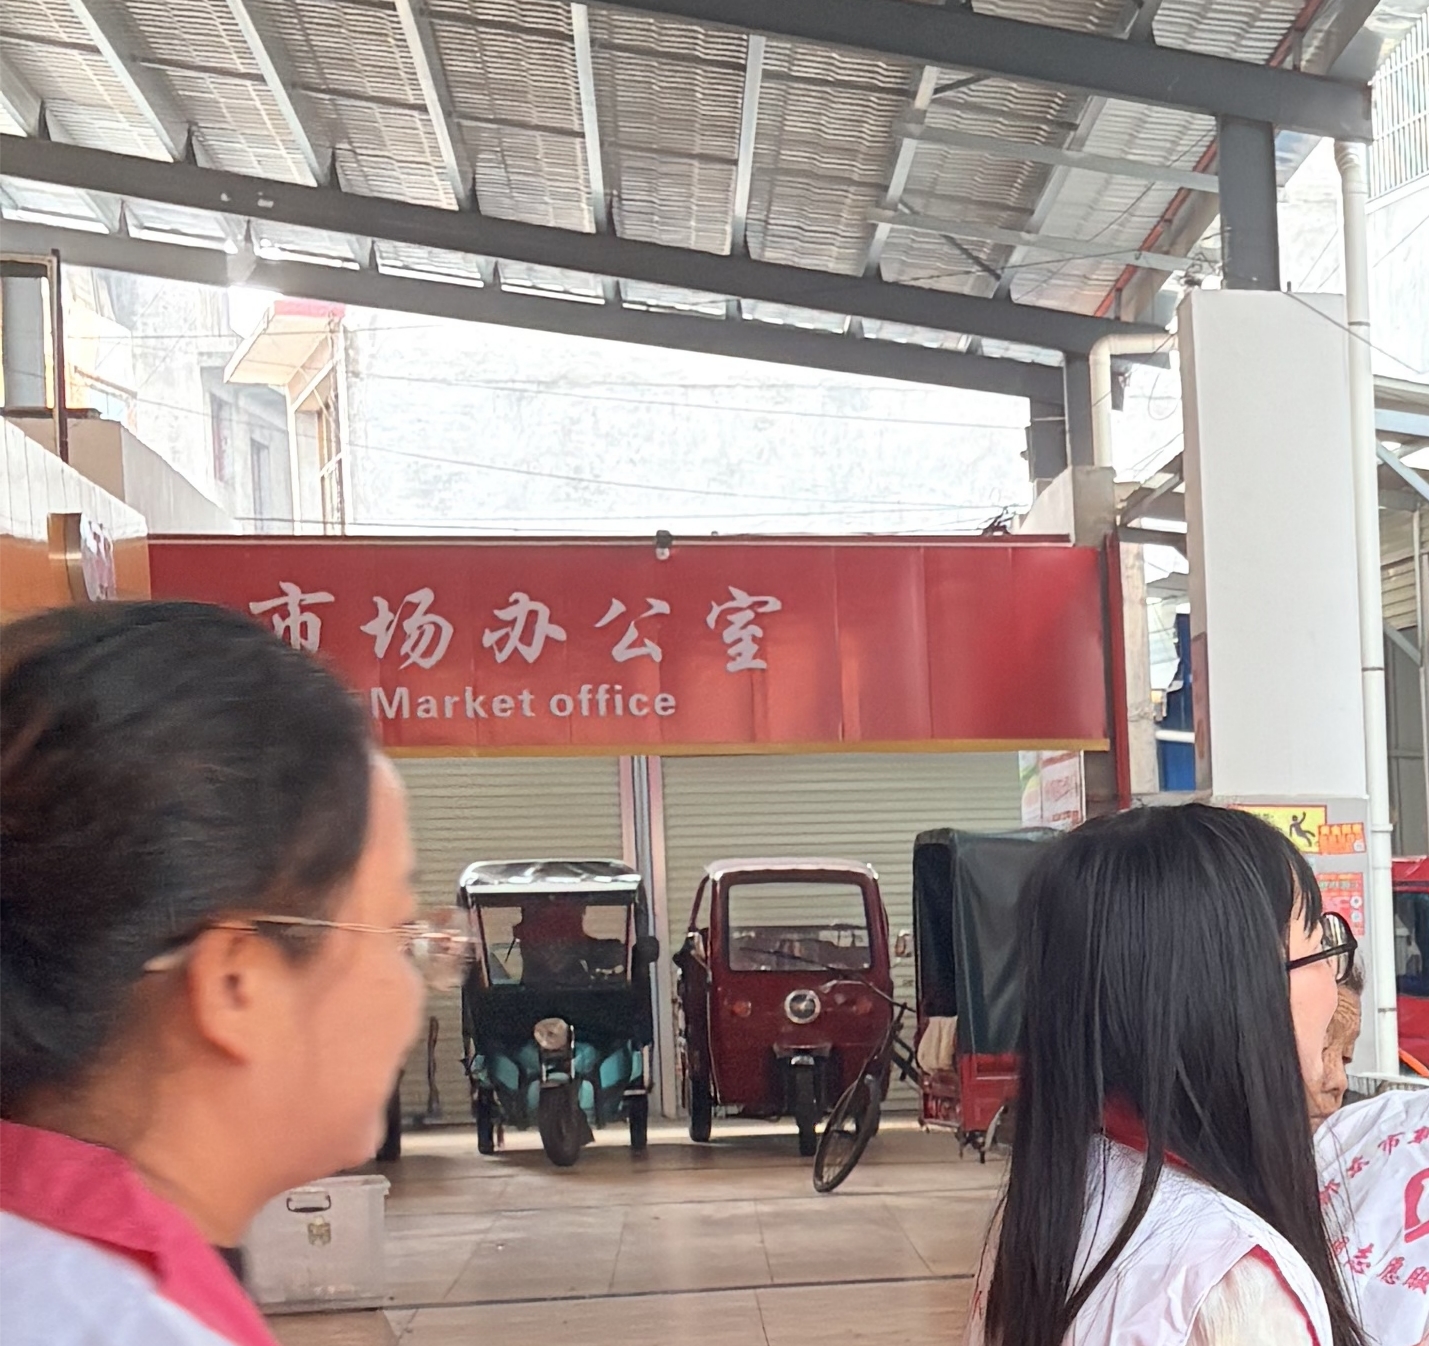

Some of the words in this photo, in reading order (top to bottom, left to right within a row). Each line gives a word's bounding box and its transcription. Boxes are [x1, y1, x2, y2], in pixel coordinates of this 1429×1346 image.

[249, 580, 782, 673] 市场办公室
[370, 685, 536, 721] Market
[548, 684, 678, 717] office
